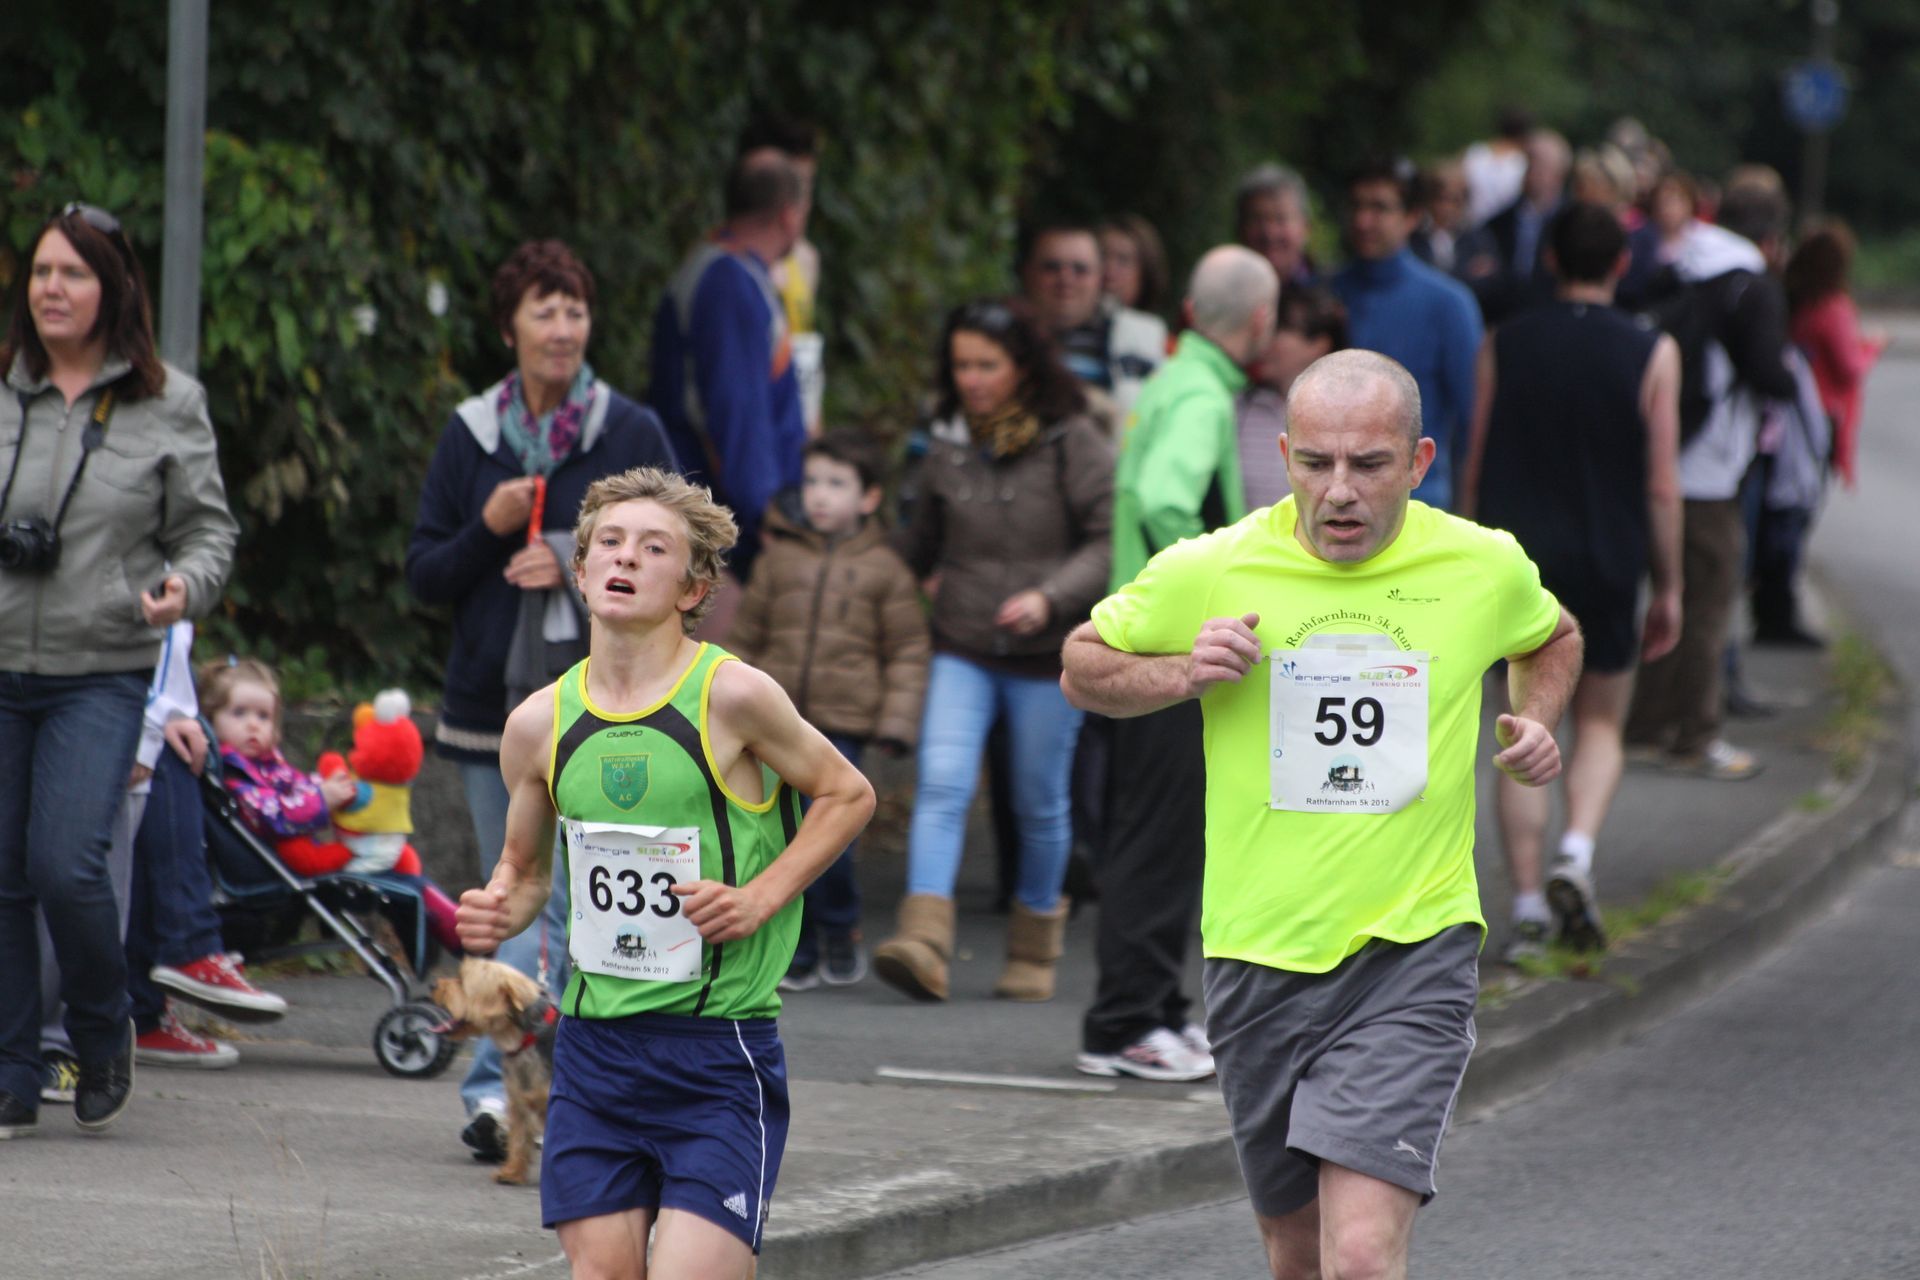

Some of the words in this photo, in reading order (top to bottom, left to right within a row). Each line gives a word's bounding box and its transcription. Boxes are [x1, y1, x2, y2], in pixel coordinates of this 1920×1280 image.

[1286, 608, 1372, 648] Rathfarnham
[1375, 616, 1390, 631] 5k
[1393, 626, 1413, 652] Run
[1314, 697, 1385, 747] 59
[1306, 798, 1357, 807] Rathfarnham
[1360, 798, 1369, 807] 5k
[1371, 799, 1390, 807] 2012
[589, 865, 681, 918] 633
[601, 960, 641, 972] Rathfarnham
